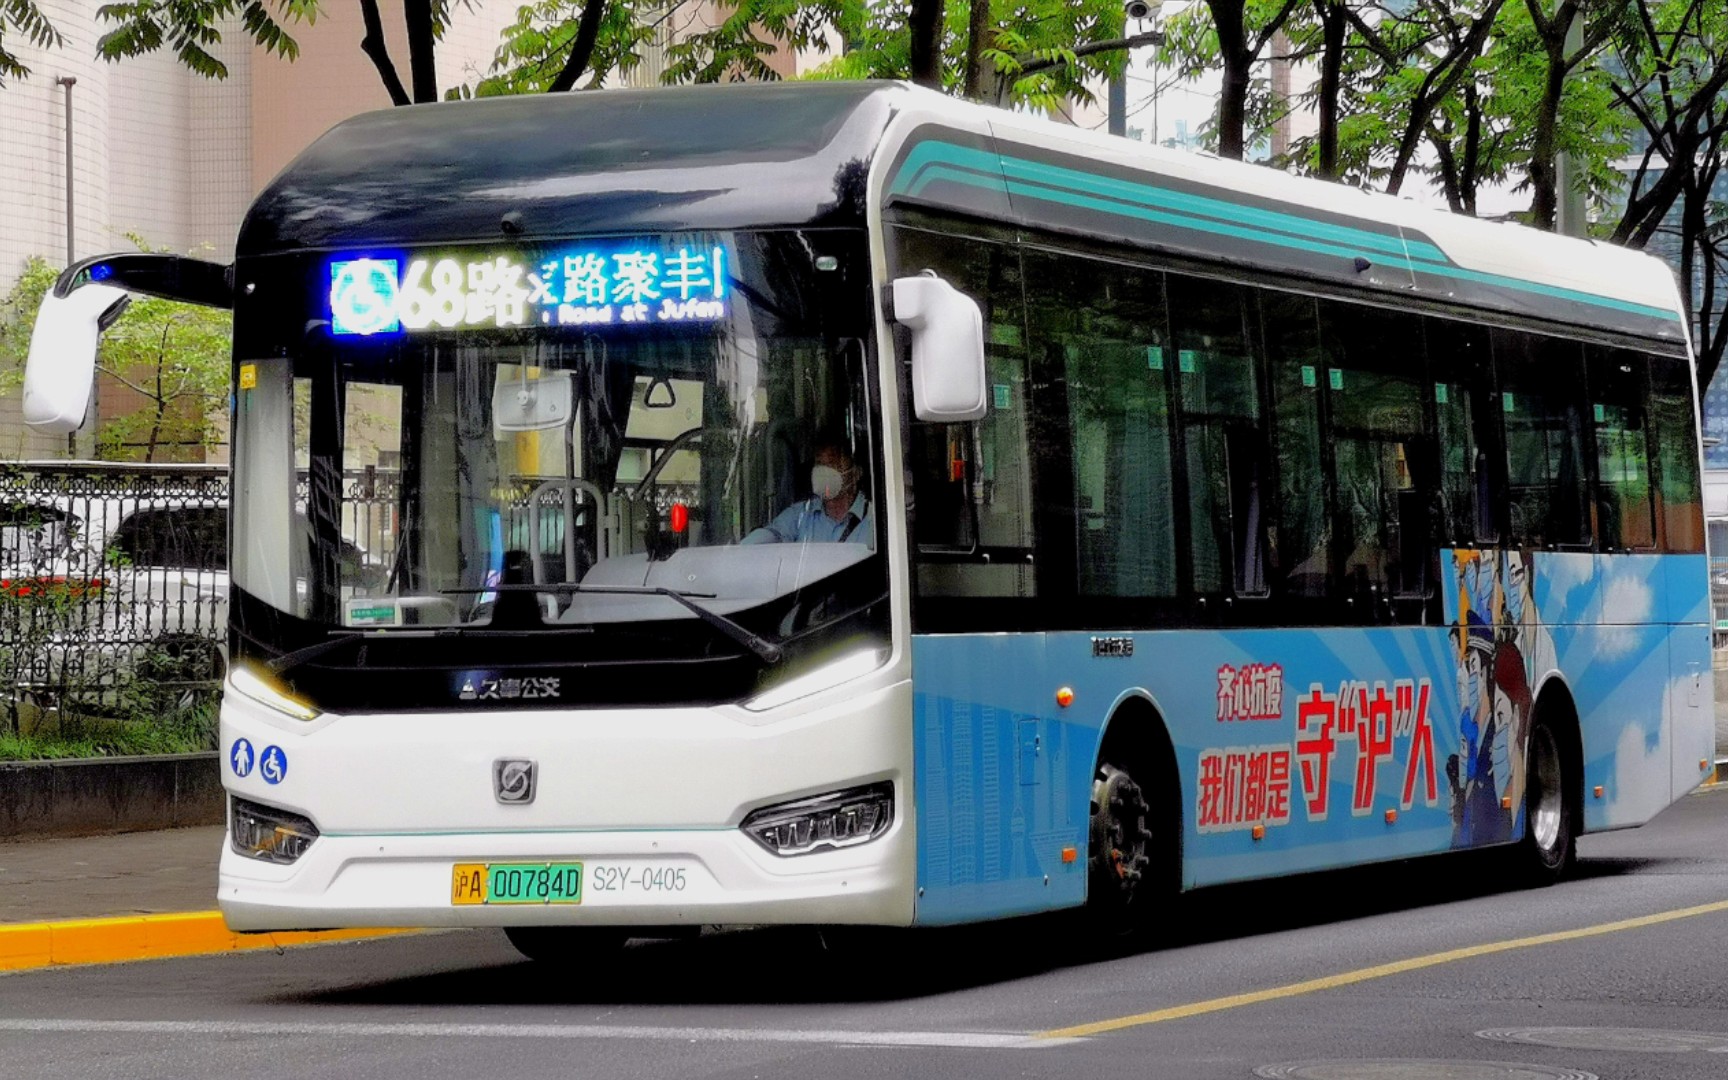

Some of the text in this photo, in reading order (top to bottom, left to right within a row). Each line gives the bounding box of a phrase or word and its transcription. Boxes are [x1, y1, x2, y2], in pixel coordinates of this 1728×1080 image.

[399, 256, 530, 328] 68路
[1217, 664, 1283, 721] 齐心抗疫
[1198, 748, 1291, 828] 我们都是
[494, 869, 579, 898] 00784D
[593, 866, 686, 892] S2Y-0405
